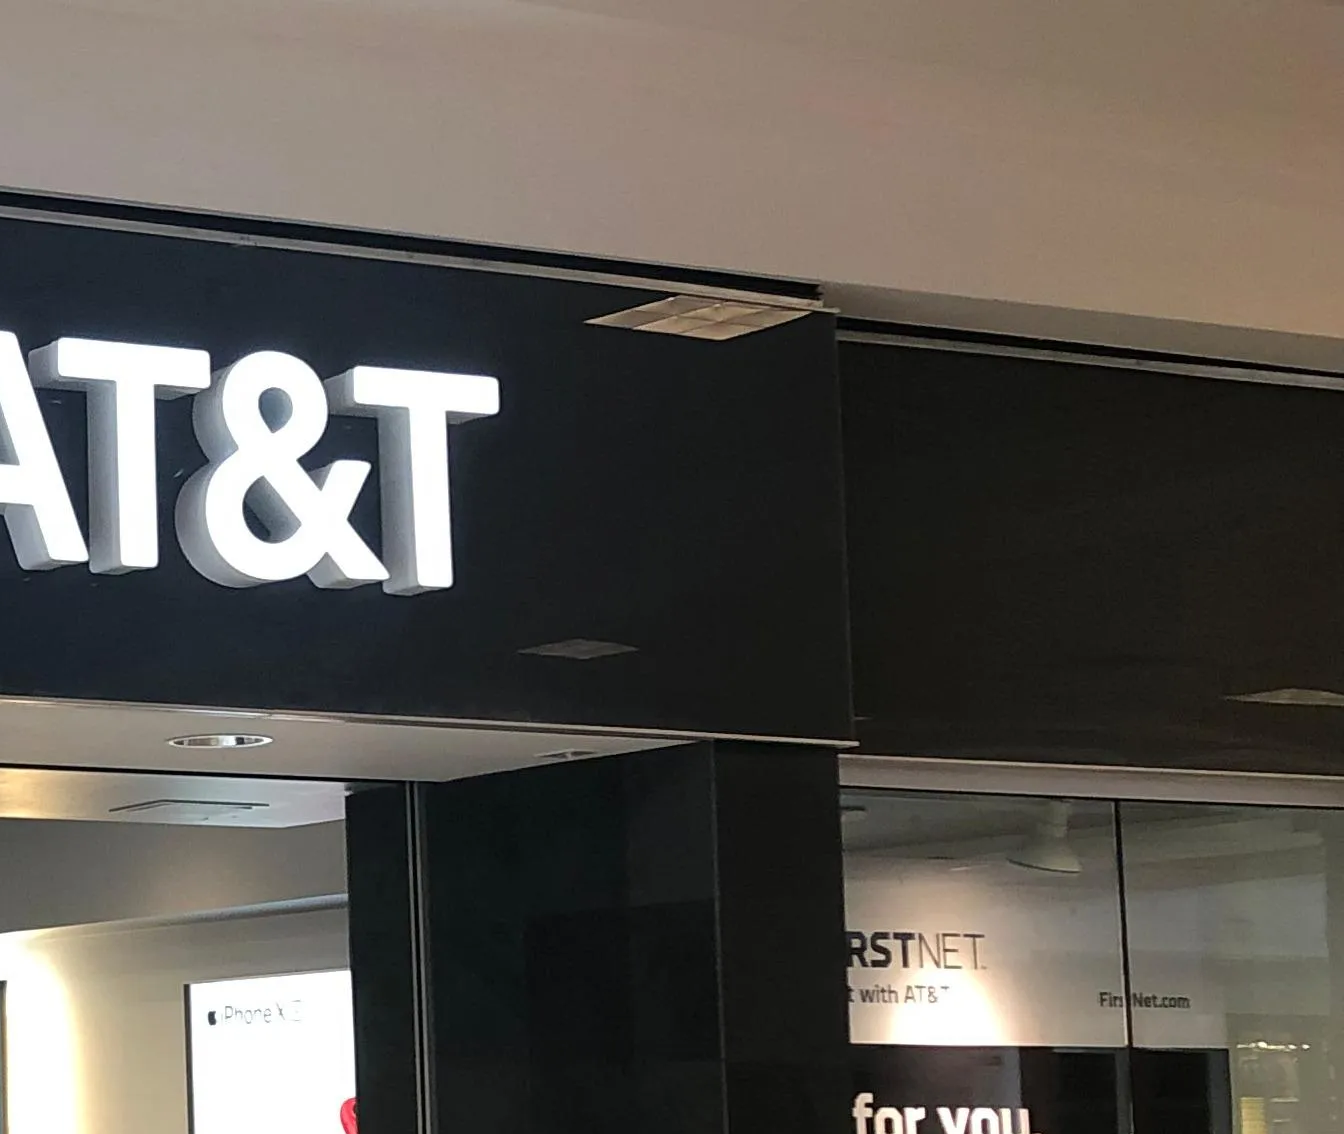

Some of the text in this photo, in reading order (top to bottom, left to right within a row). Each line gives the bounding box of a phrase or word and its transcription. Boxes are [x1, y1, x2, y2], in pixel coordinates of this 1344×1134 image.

[846, 931, 986, 969] RSTNET
[859, 984, 899, 1004] with
[1099, 992, 1191, 1009] FirNet.com
